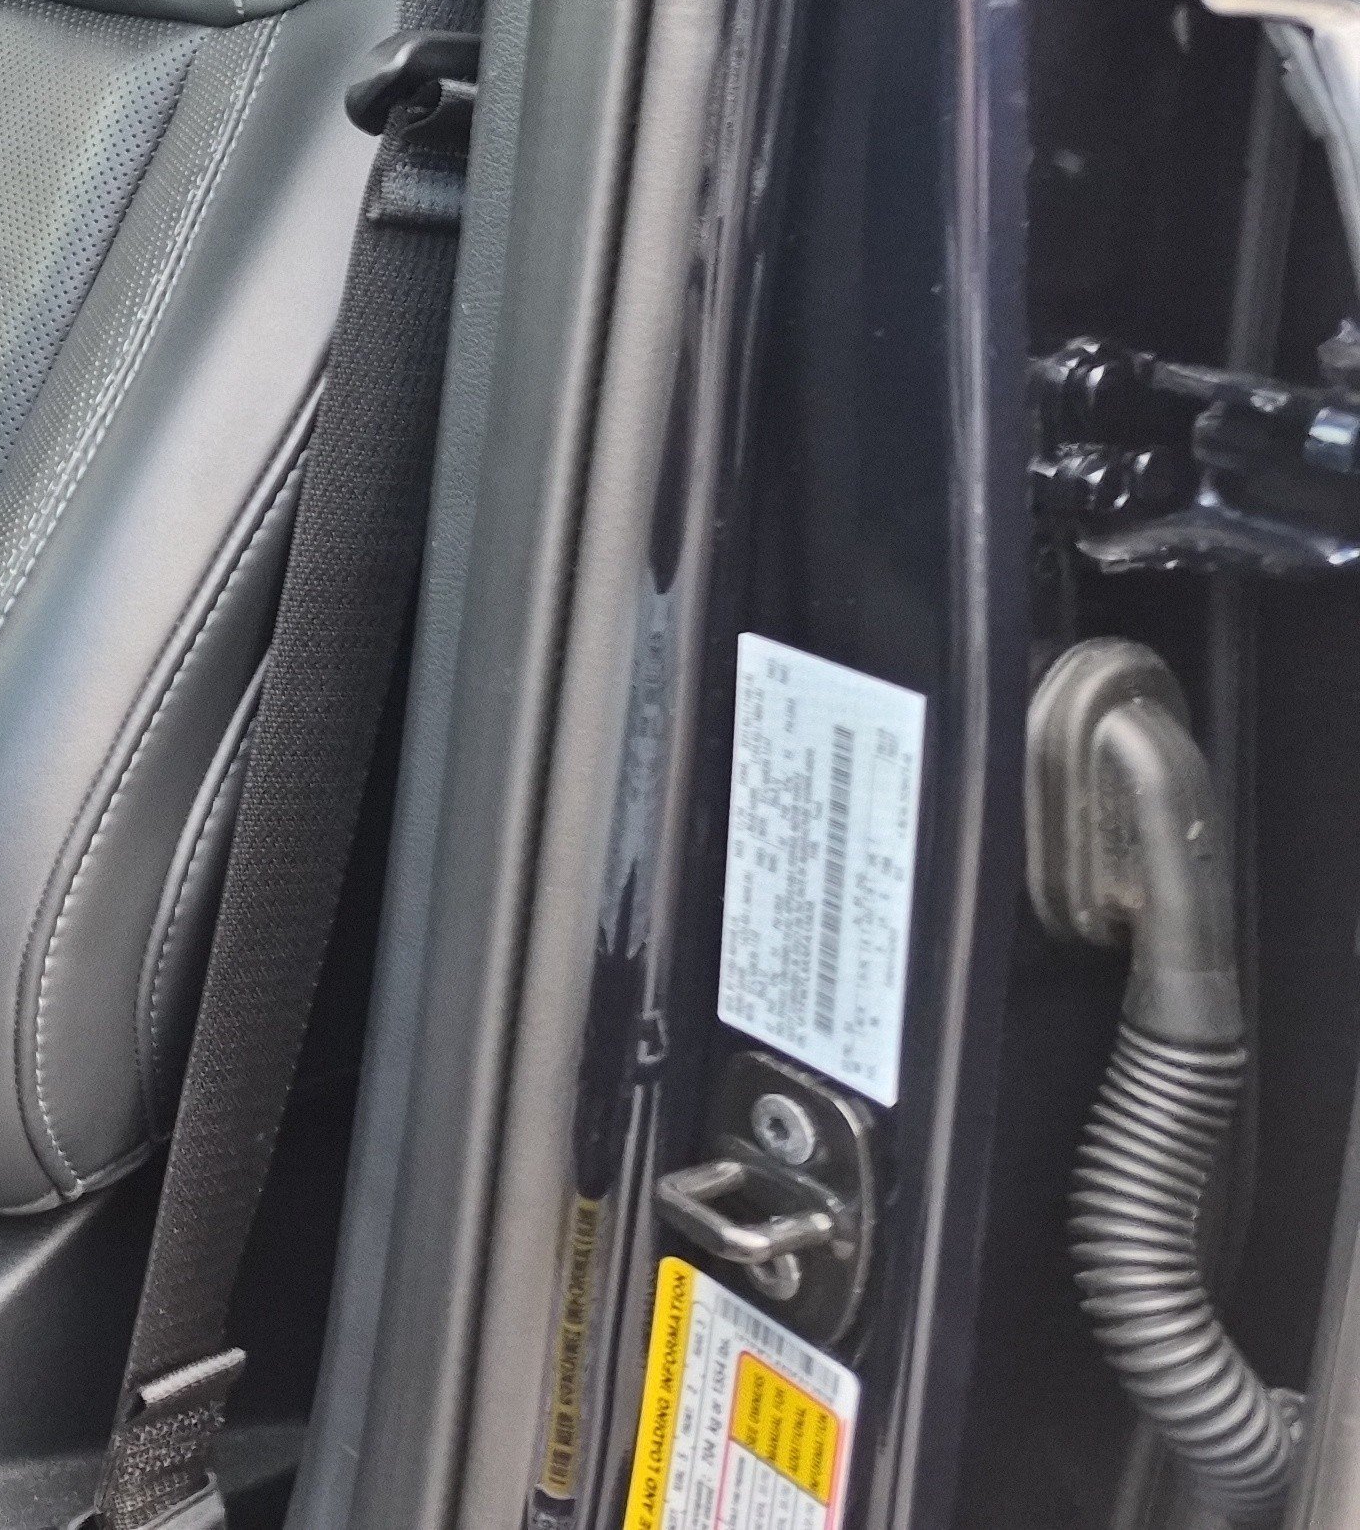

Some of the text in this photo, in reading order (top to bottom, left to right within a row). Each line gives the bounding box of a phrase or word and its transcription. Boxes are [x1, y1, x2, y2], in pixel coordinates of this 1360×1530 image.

[660, 1273, 688, 1393] INFORMATION
[646, 1396, 672, 1475] LOADING
[642, 1476, 659, 1512] AND
